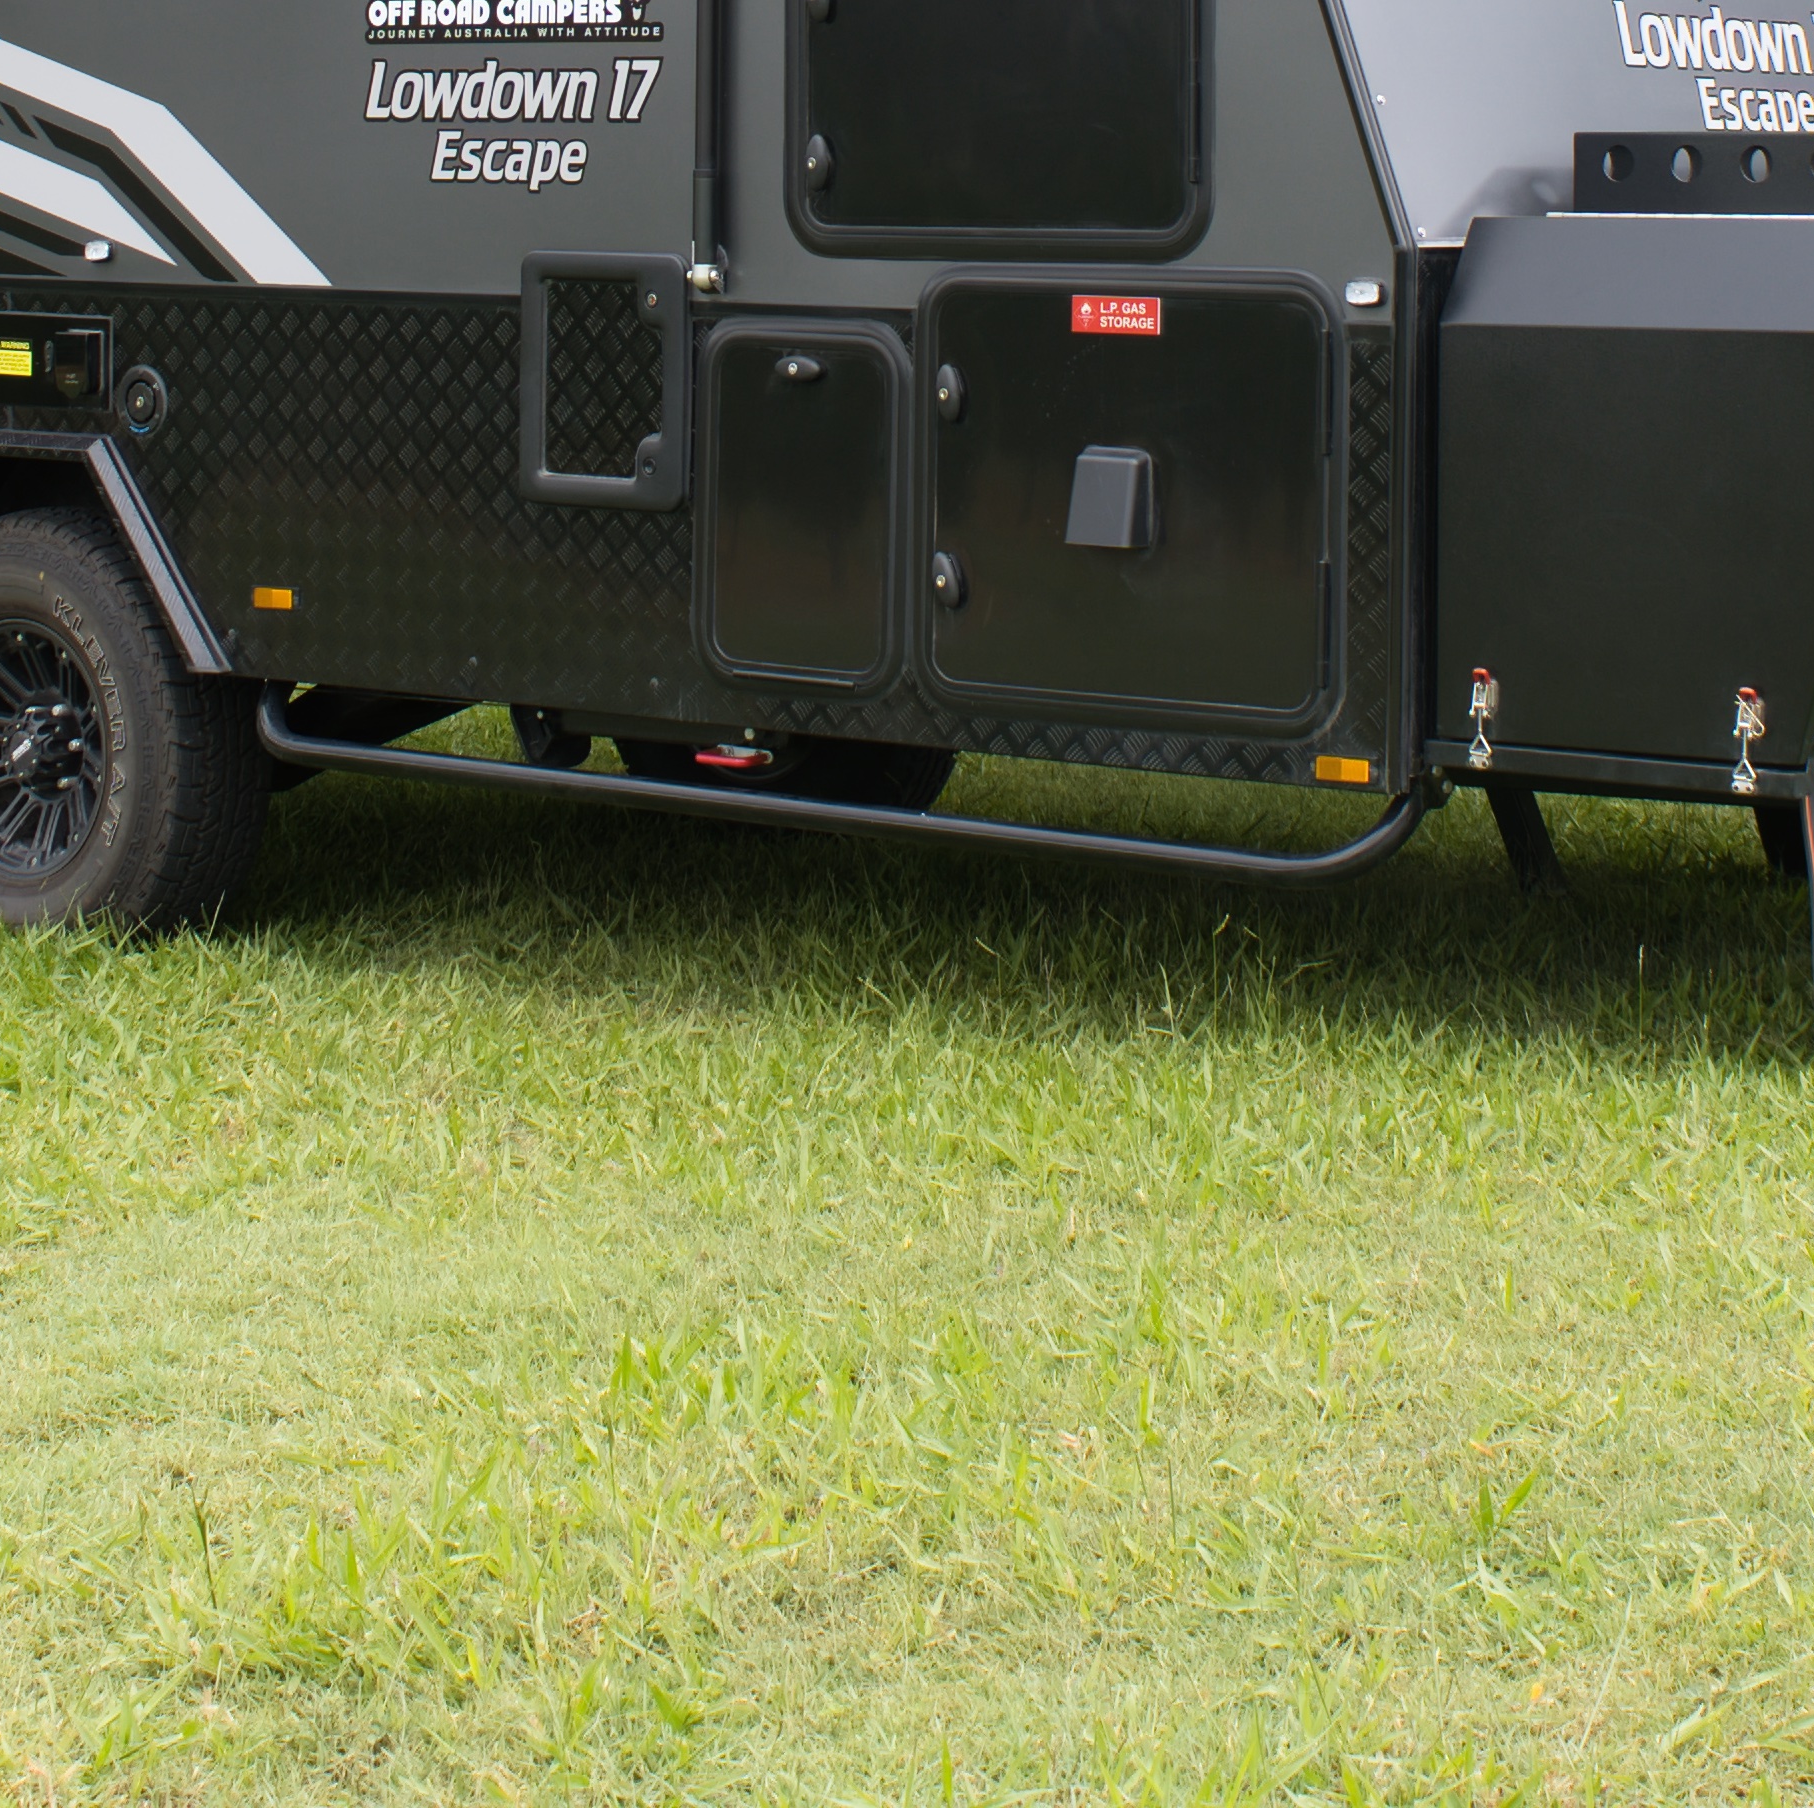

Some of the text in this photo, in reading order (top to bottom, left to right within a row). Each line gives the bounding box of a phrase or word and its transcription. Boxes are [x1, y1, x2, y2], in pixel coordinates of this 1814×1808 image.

[367, 25, 661, 40] JOURNEY AUSTRALIA WITH ATTITUDE
[365, 59, 662, 120] Lowdown 17
[431, 130, 588, 192] Escape
[1121, 302, 1147, 315] GAS
[1099, 315, 1155, 330] STORAGE
